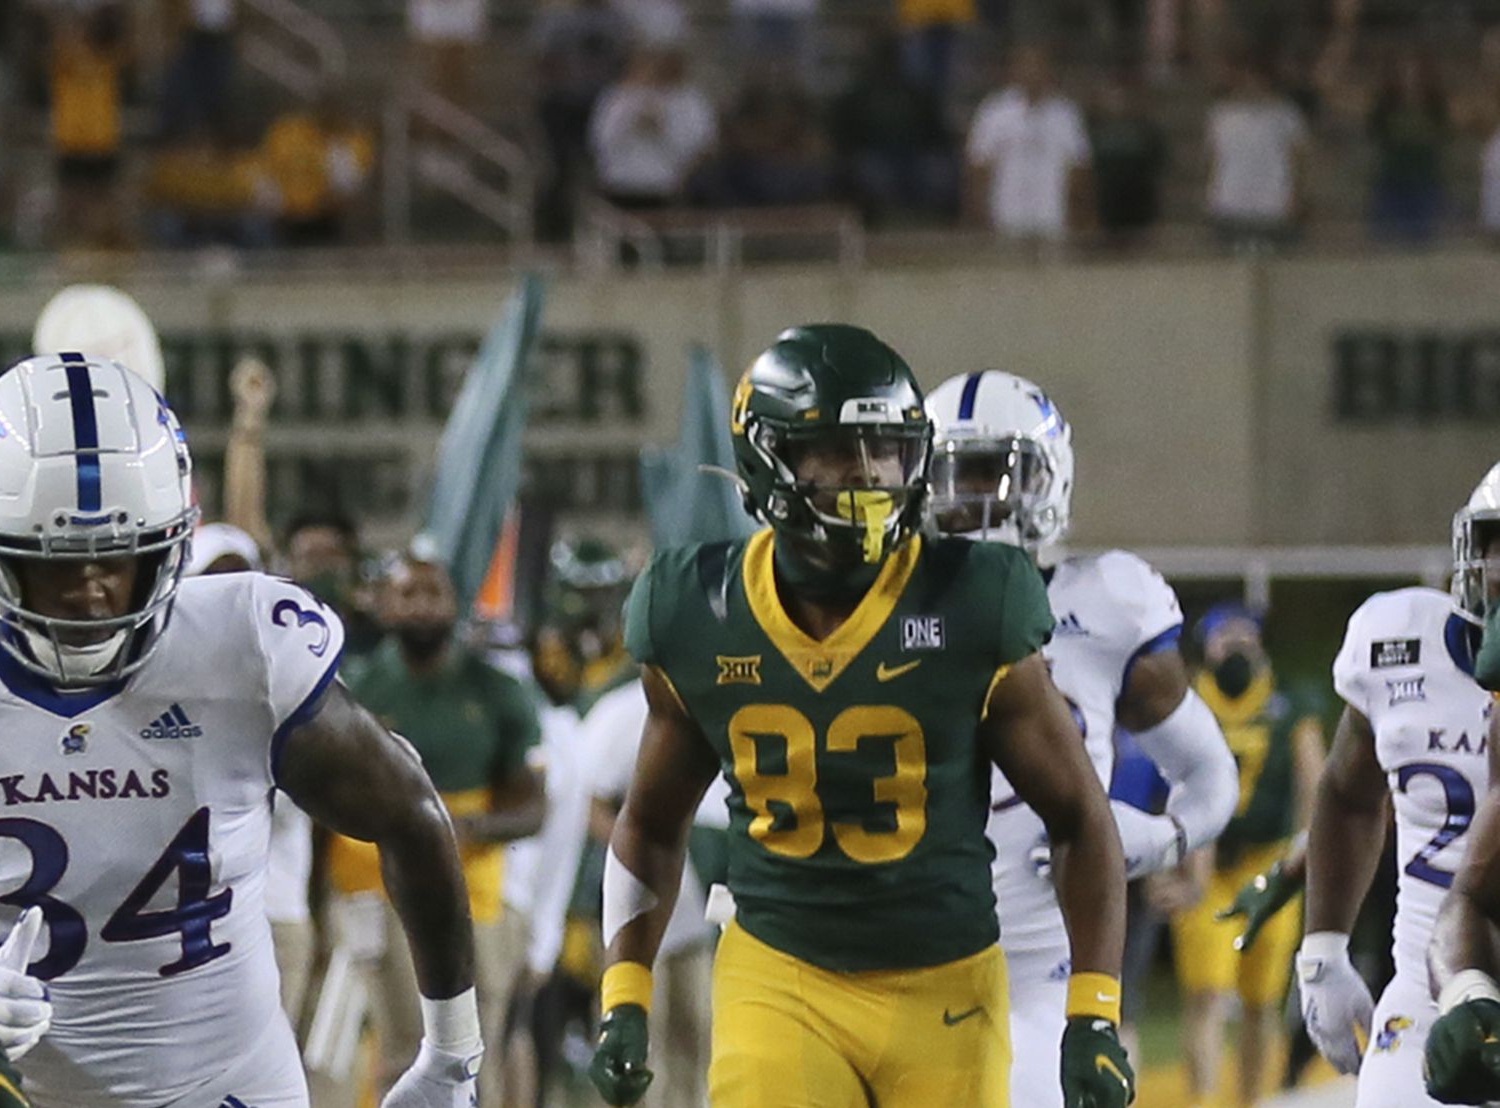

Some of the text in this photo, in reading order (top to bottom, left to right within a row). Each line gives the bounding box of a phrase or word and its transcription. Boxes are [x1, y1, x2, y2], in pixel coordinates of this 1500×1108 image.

[271, 589, 332, 658] 3
[905, 617, 941, 641] ONE
[140, 724, 203, 740] adidas
[728, 704, 928, 865] 83
